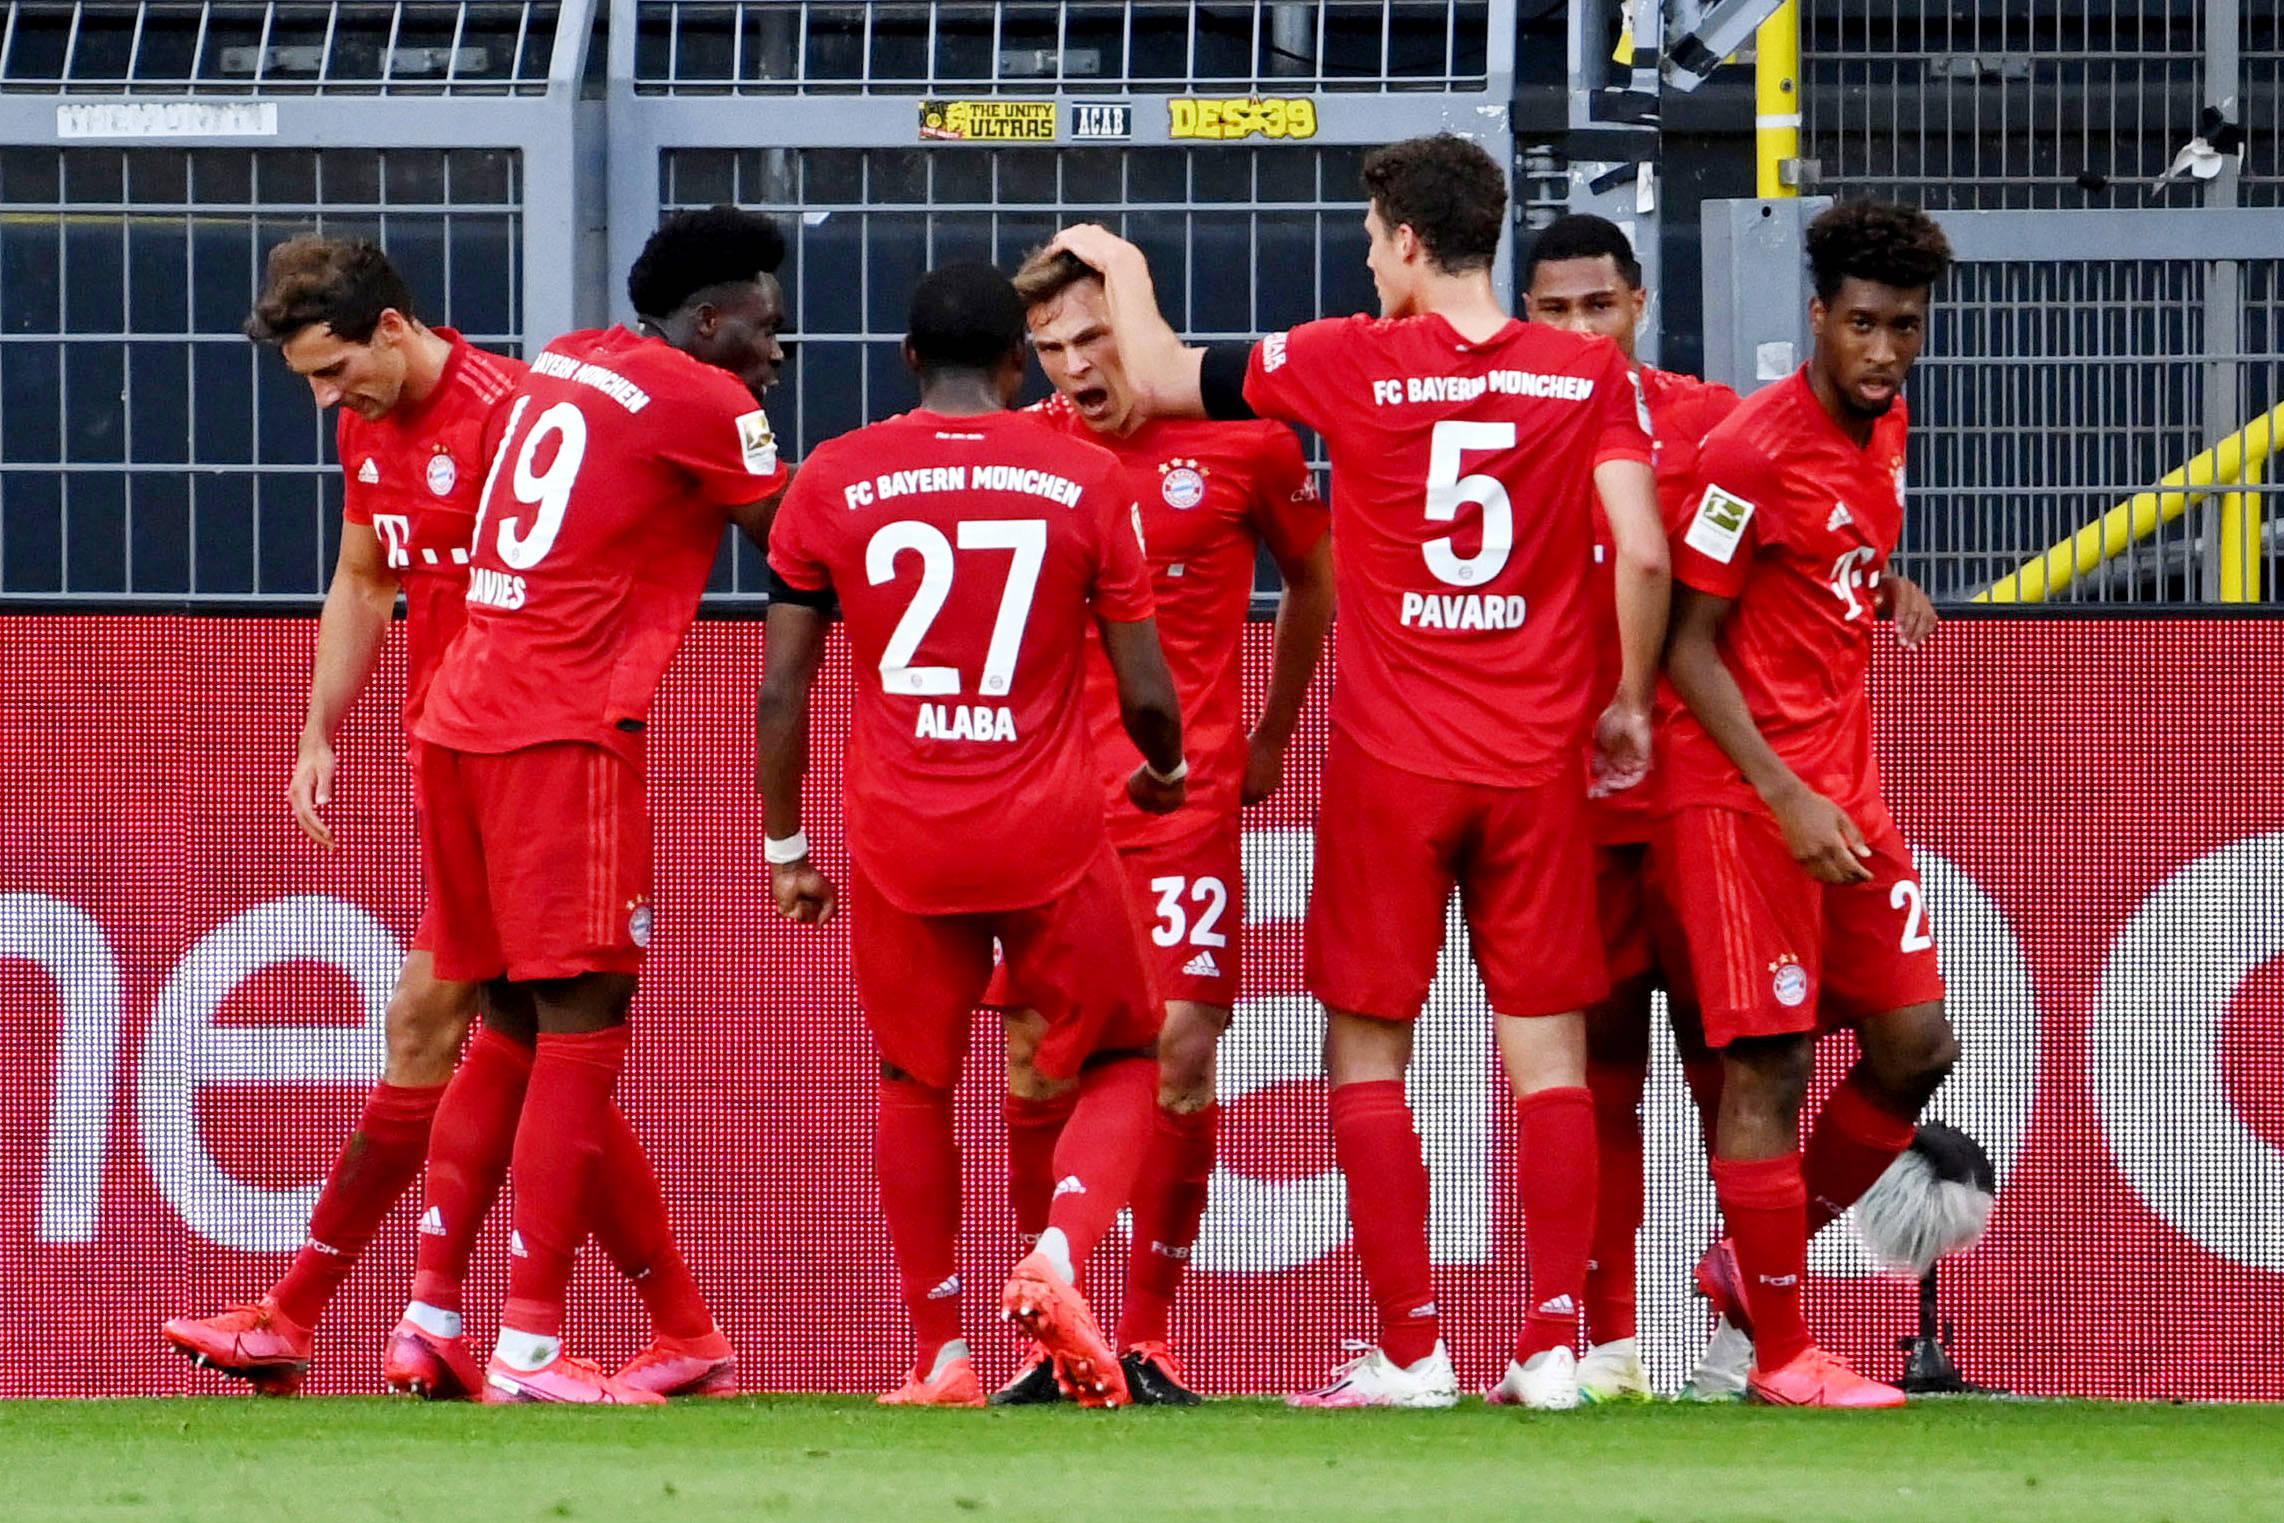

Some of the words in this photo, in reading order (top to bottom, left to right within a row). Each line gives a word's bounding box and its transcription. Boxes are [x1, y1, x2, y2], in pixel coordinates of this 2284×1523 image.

[970, 104, 1000, 117] THE
[1004, 104, 1053, 117] UNITY
[970, 119, 1053, 137] ULTRAS
[1078, 107, 1124, 136] ACAB
[1373, 379, 1403, 406] FC
[1406, 375, 1488, 403] BAYERN
[470, 395, 588, 569] 19
[844, 480, 874, 510] FC
[876, 466, 966, 500] BAYERN
[1421, 420, 1517, 587] 5
[865, 518, 1048, 696] 27
[1401, 591, 1527, 630] PAVARD
[915, 702, 1018, 742] ALABA
[1151, 875, 1228, 948] 32
